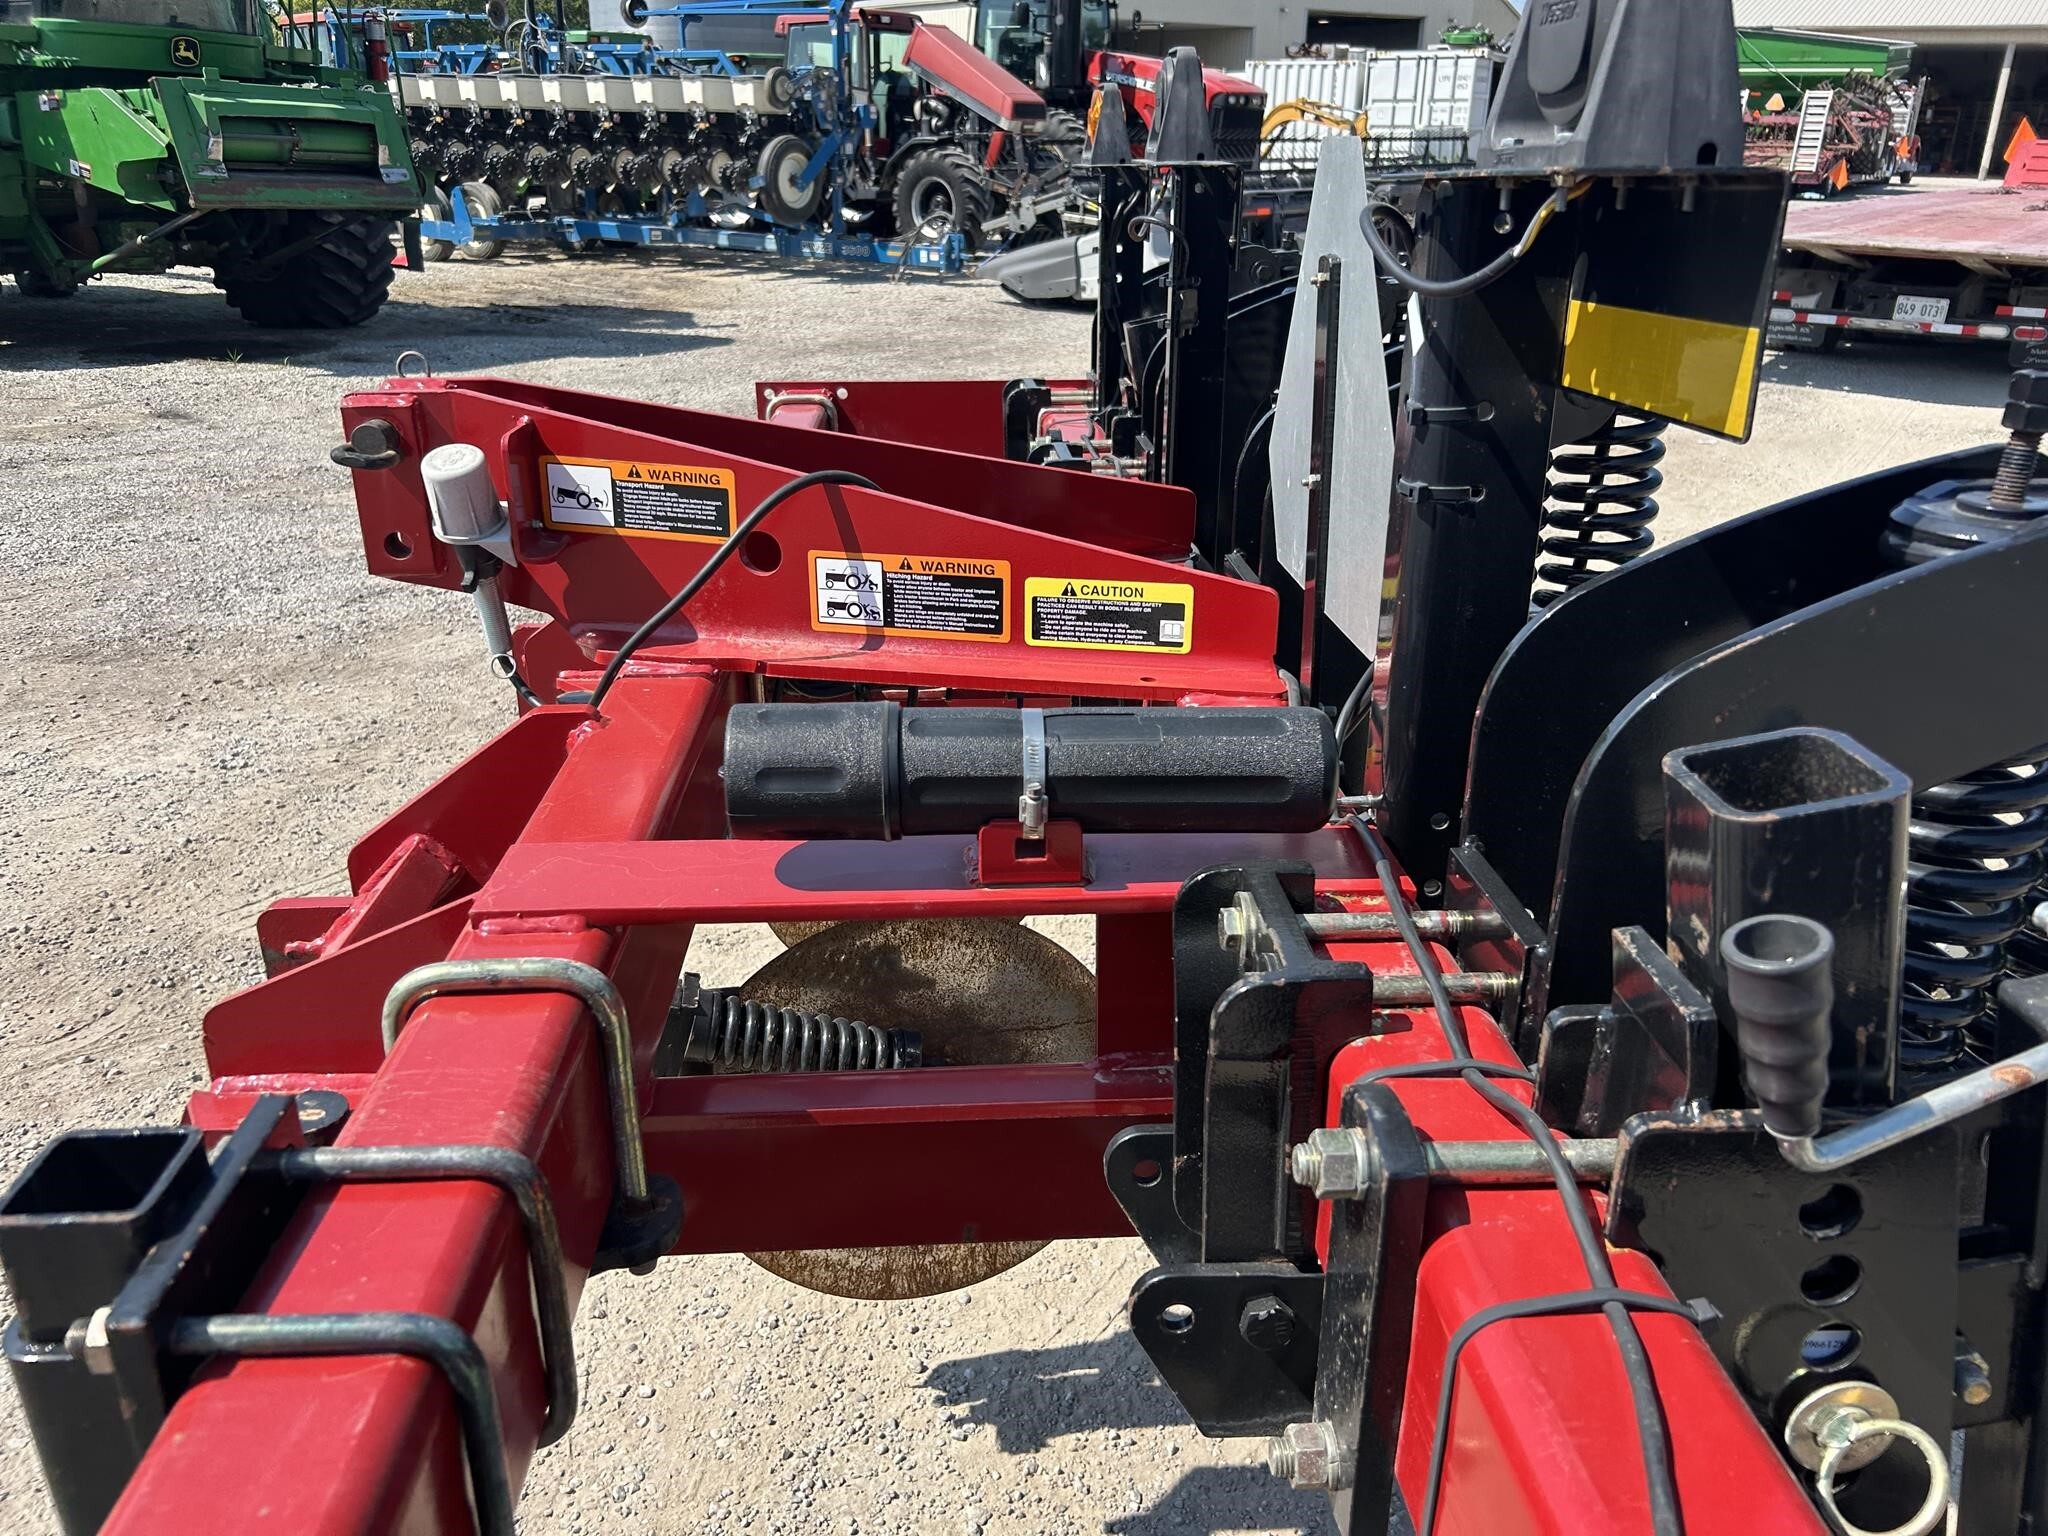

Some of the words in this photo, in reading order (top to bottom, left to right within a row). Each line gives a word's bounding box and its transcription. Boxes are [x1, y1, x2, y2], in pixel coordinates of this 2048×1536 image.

[1896, 302, 1916, 315] 849
[1920, 303, 1940, 317] 073
[648, 469, 721, 485] WARNING
[920, 560, 996, 575] WARNING
[887, 573, 911, 581] Hitching
[1080, 584, 1144, 598] CAUTION
